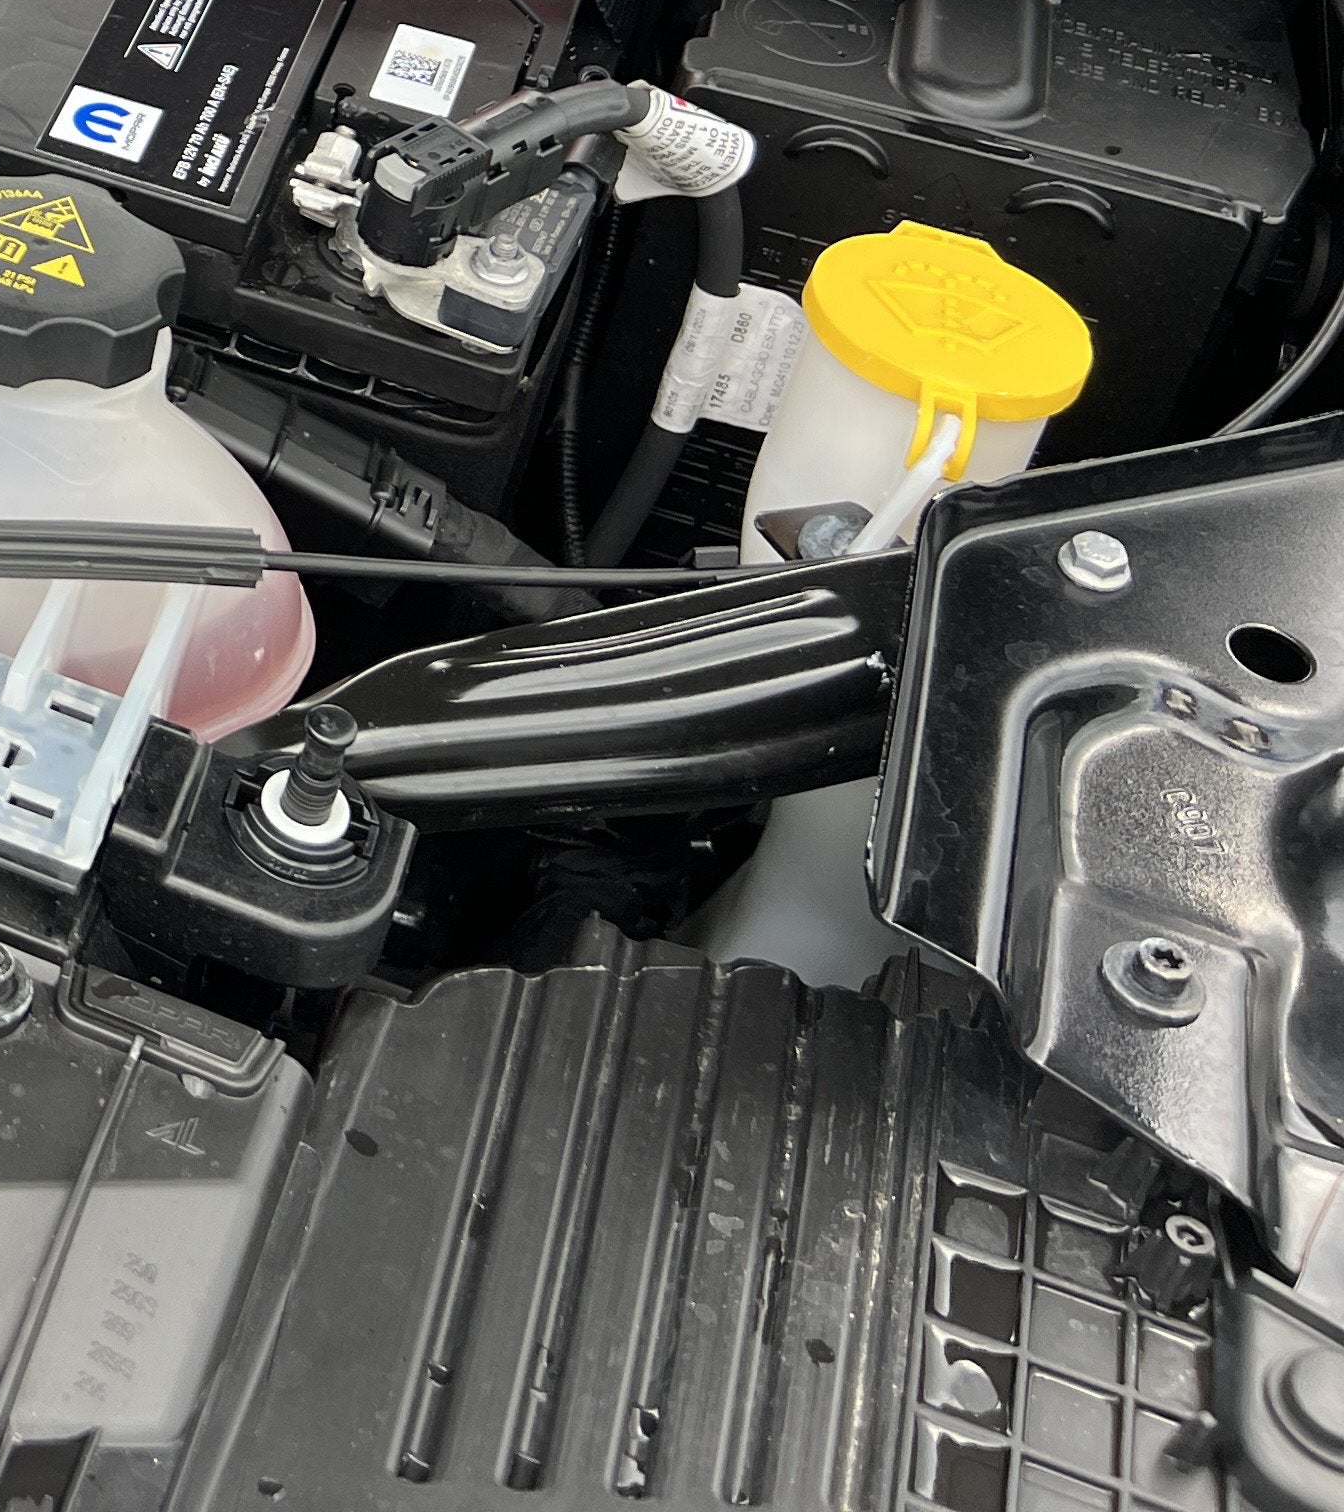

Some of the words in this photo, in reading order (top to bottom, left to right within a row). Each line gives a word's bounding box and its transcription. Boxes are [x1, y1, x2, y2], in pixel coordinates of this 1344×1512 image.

[199, 105, 218, 125] 700
[121, 112, 146, 151] MOPAR
[189, 132, 205, 148] 70
[651, 117, 674, 141] OUT
[705, 127, 719, 149] ON
[182, 145, 200, 164] 12V
[713, 130, 730, 157] THE
[715, 132, 741, 171] WHEN
[173, 160, 192, 180] EFB
[196, 175, 213, 188] by
[762, 305, 786, 349] ESATTO
[709, 373, 731, 410] 17485
[731, 312, 753, 344] D860
